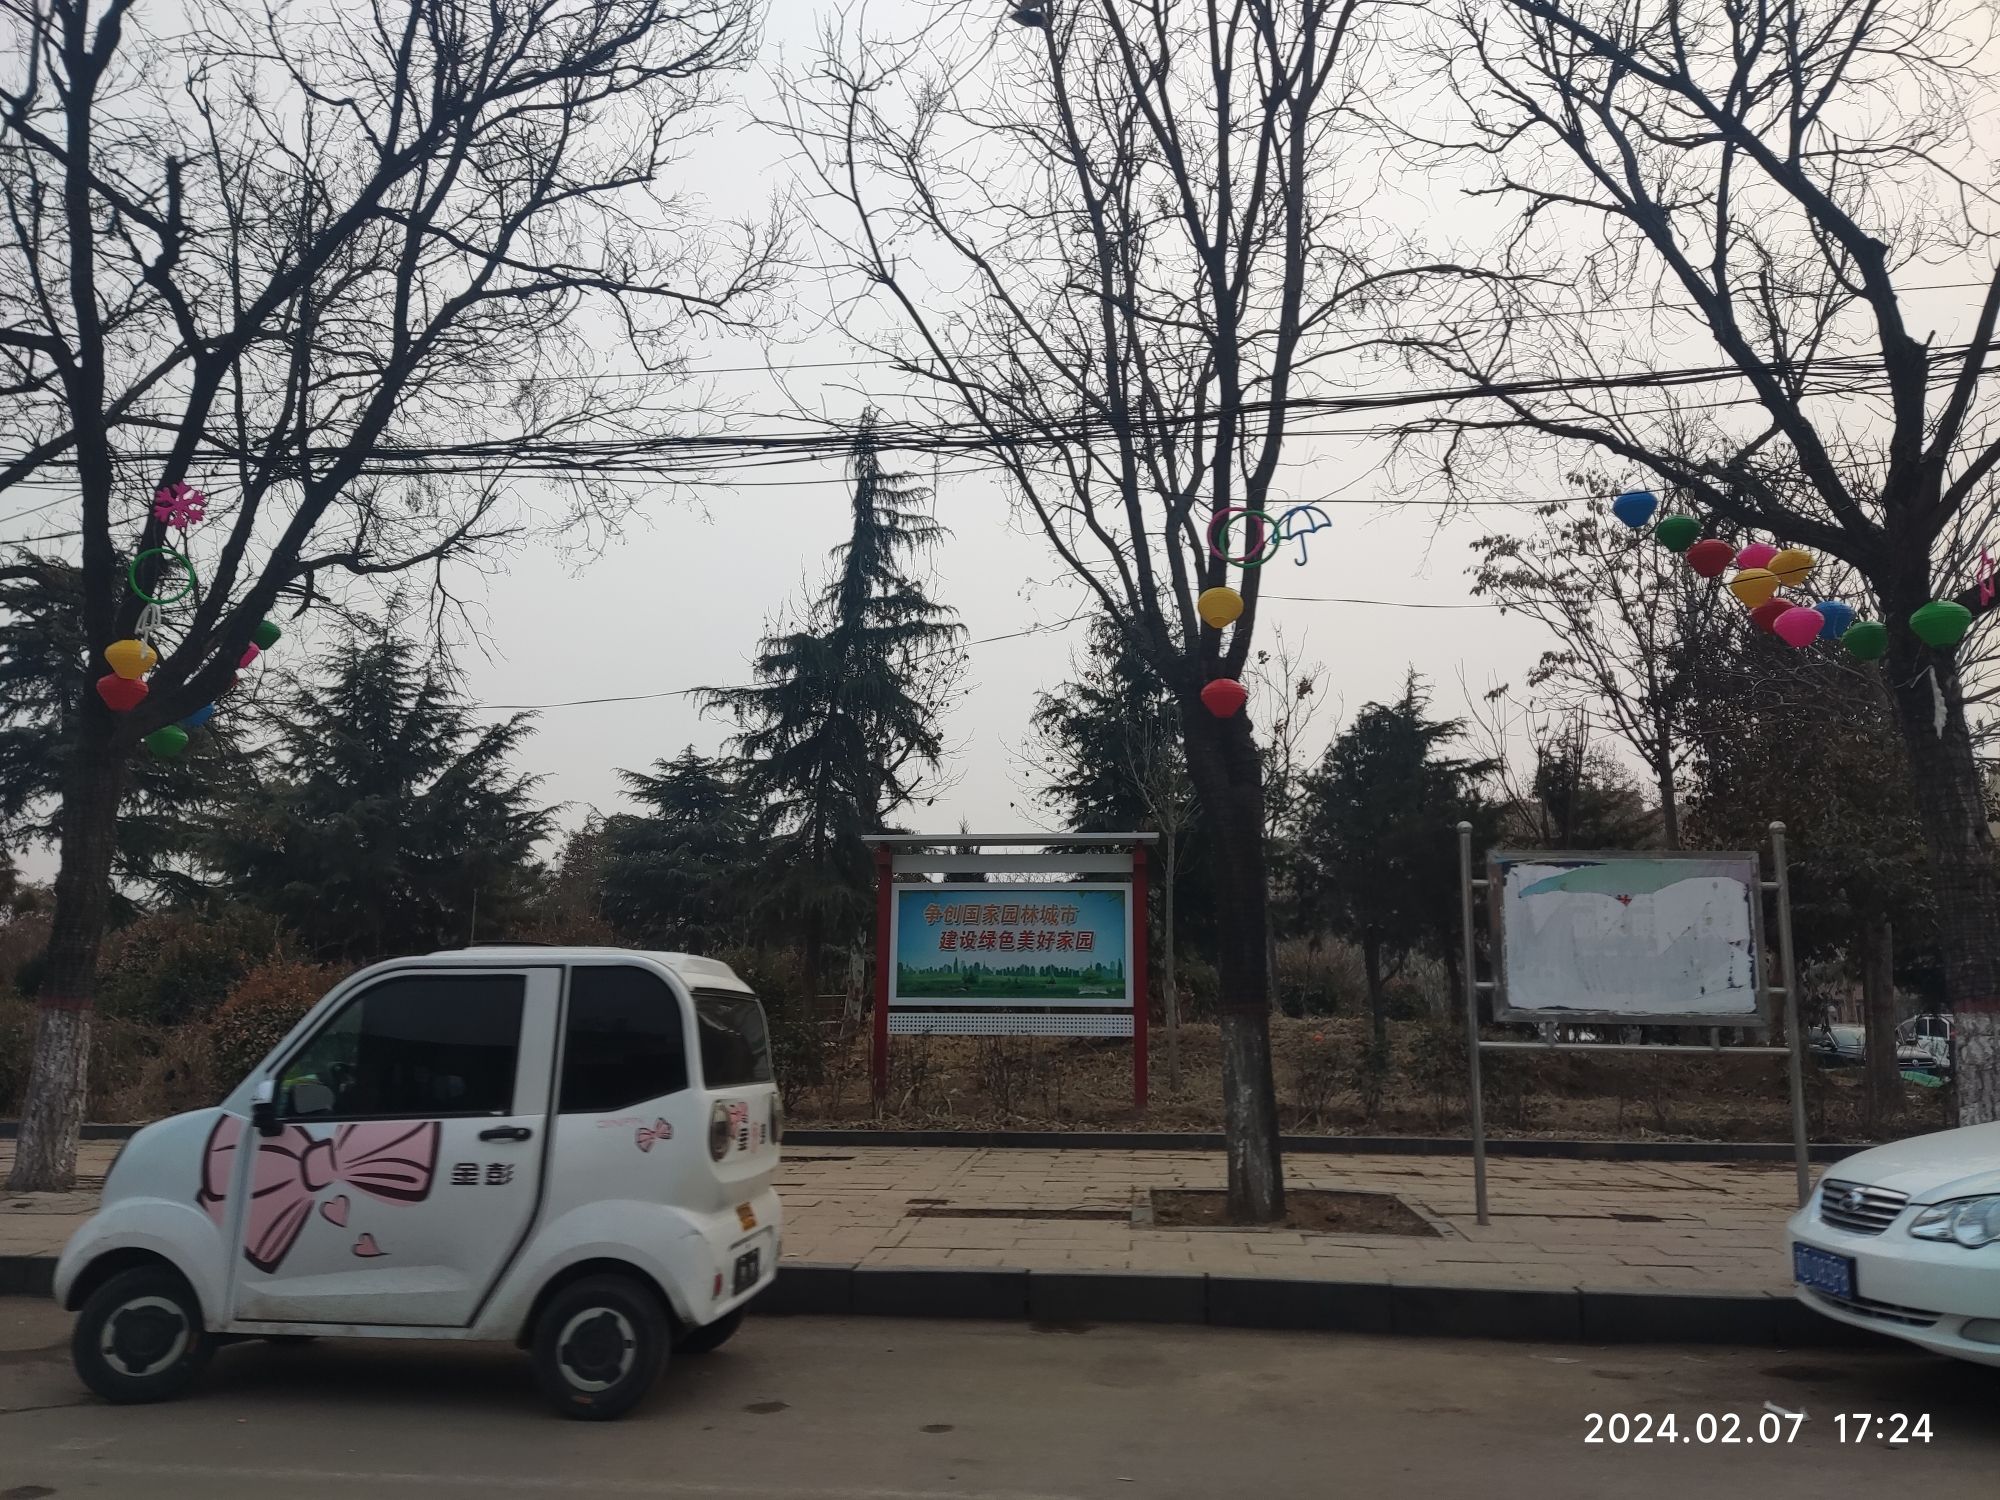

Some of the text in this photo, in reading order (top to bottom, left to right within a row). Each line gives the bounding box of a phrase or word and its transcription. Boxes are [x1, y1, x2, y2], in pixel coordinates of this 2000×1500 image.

[923, 903, 1079, 926] 争创国家园林城市
[938, 930, 1096, 952] 建设绿色美好家园
